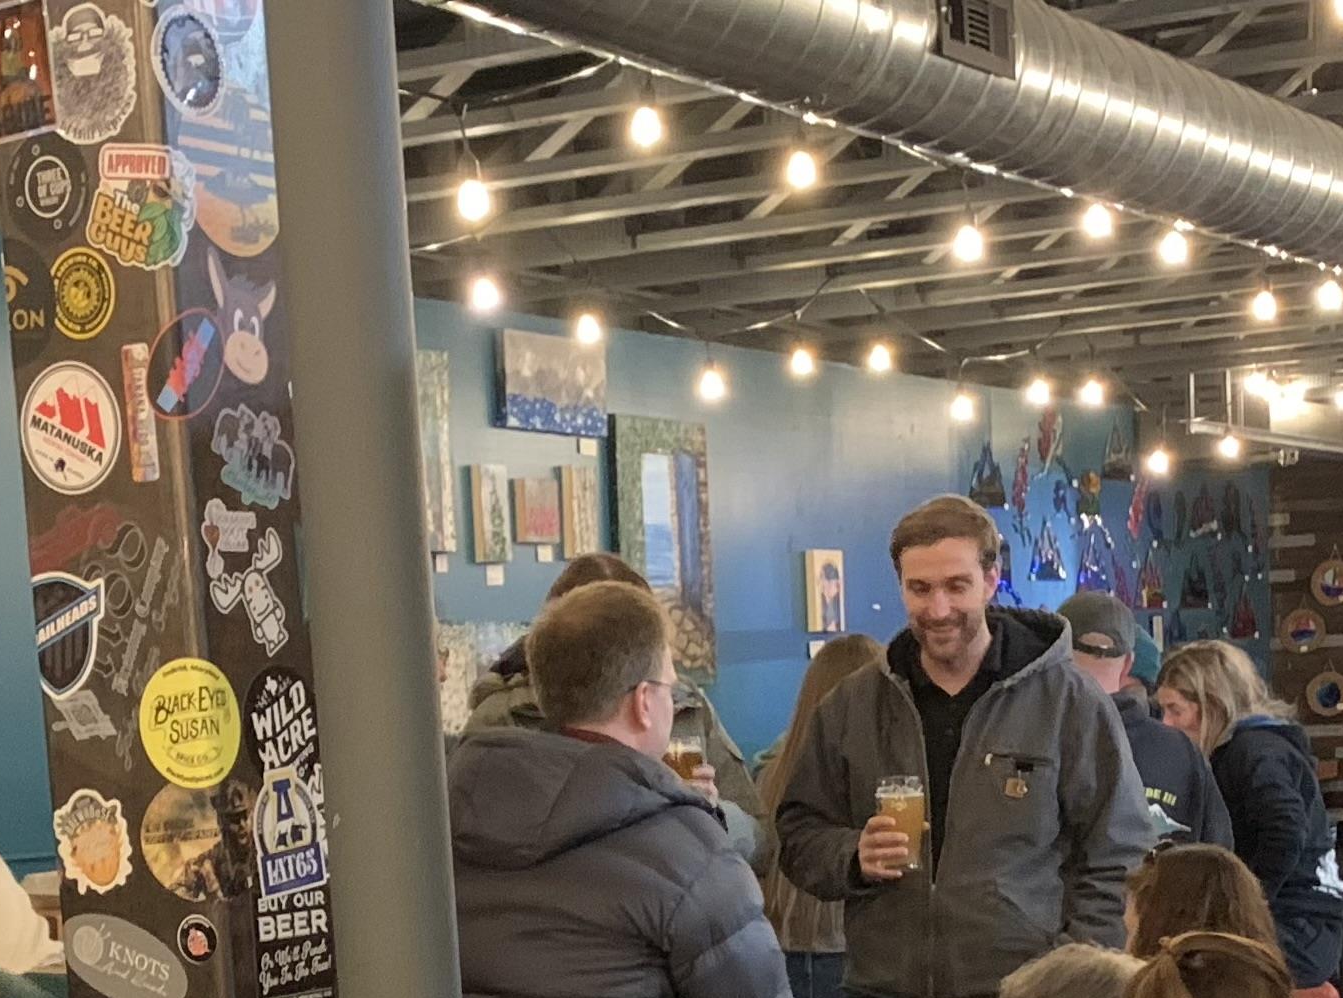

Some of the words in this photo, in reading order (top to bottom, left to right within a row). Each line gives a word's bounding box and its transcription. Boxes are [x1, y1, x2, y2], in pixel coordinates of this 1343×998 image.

[107, 154, 167, 175] APPROVED
[94, 194, 152, 245] BEER
[115, 191, 141, 215] The
[88, 220, 147, 263] Guys
[29, 414, 104, 467] MATANUSKA
[36, 594, 98, 647] AILHEADS
[251, 680, 306, 740] WILD
[169, 717, 220, 745] SUSAN
[257, 707, 317, 772] ACRE
[266, 847, 318, 887] LAT65
[257, 894, 288, 914] BUY
[293, 890, 325, 908] OUR
[257, 909, 329, 942] BEER
[108, 941, 170, 982] KNOTS
